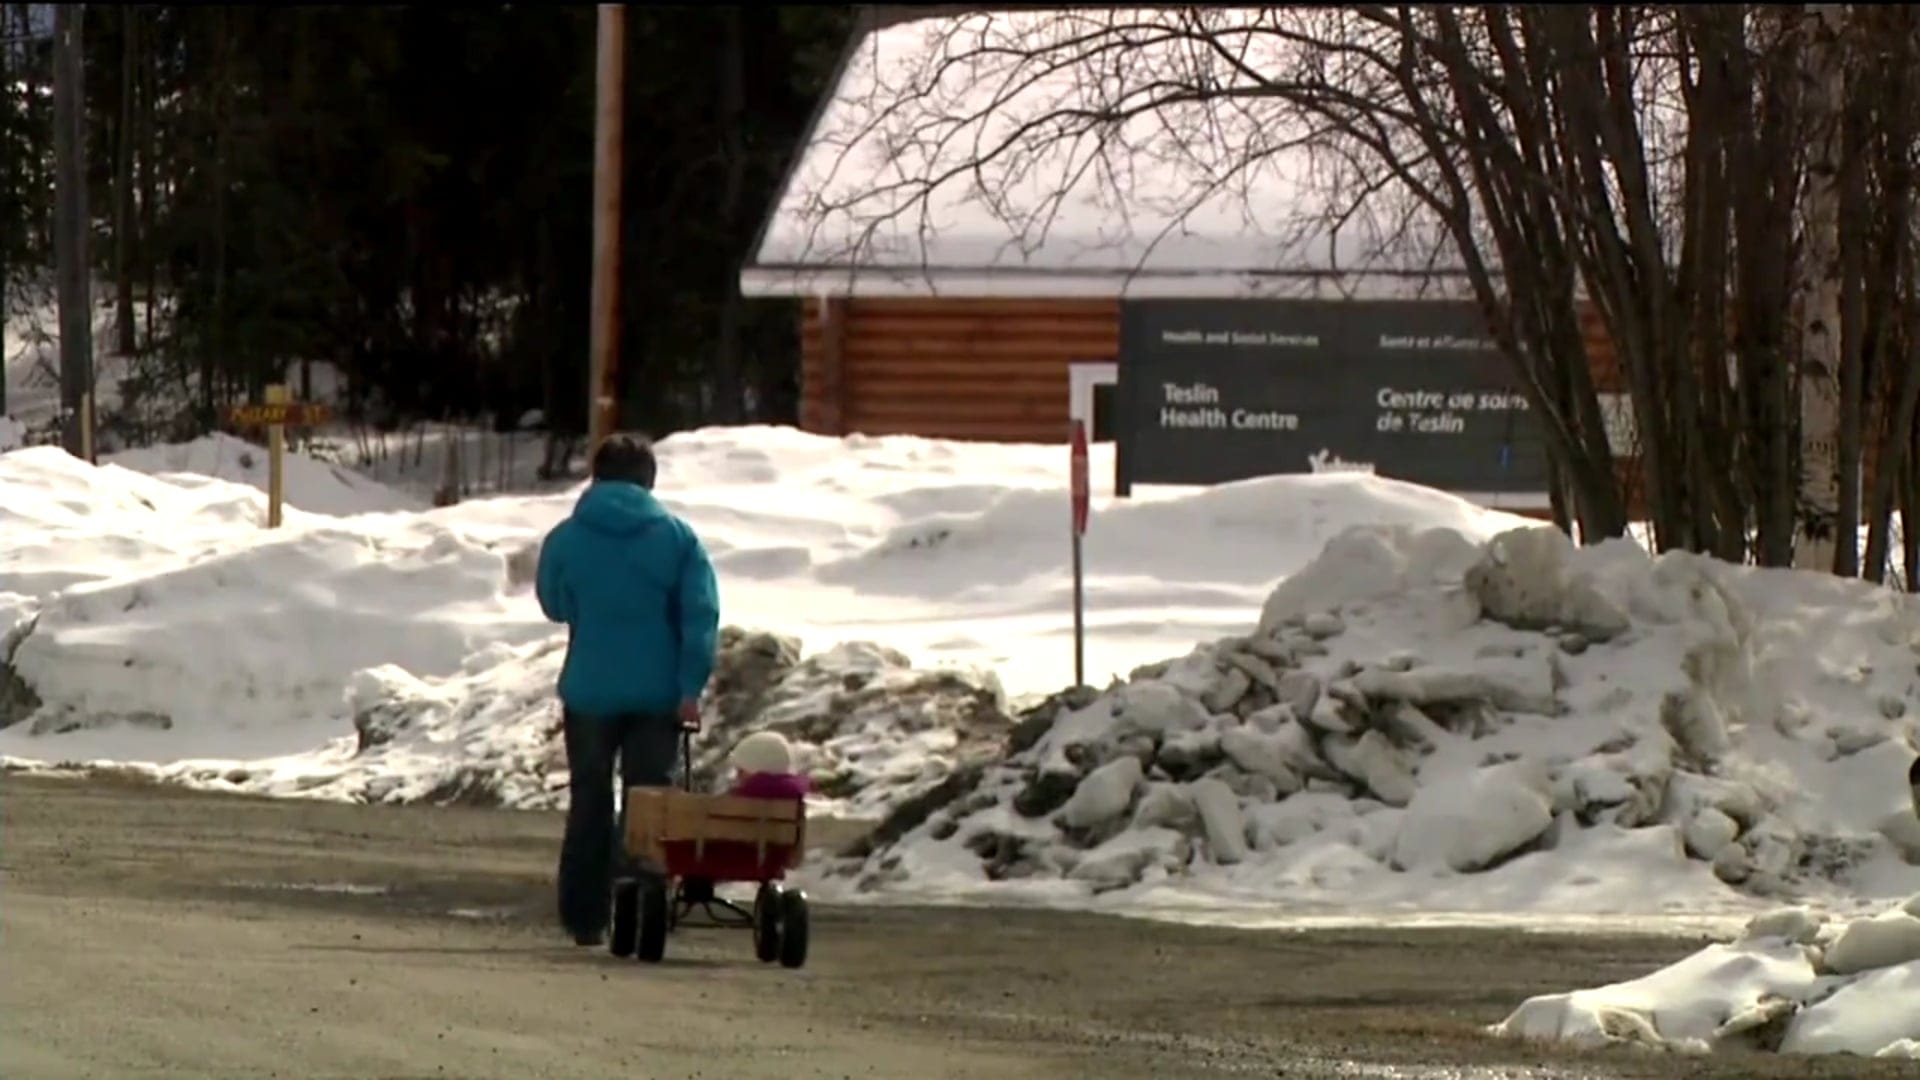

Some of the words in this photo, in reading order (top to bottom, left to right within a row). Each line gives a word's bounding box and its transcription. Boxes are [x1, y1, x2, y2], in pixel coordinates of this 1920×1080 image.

[1162, 330, 1202, 344] Health
[1206, 331, 1230, 344] and
[1232, 331, 1267, 345] Social
[1163, 382, 1219, 404] Teslin
[1376, 387, 1444, 410] Centre
[1448, 388, 1475, 410] de
[1160, 407, 1227, 429] Health
[1231, 408, 1298, 430] Centre
[1376, 411, 1404, 431] de
[1407, 412, 1465, 433] Teslin
